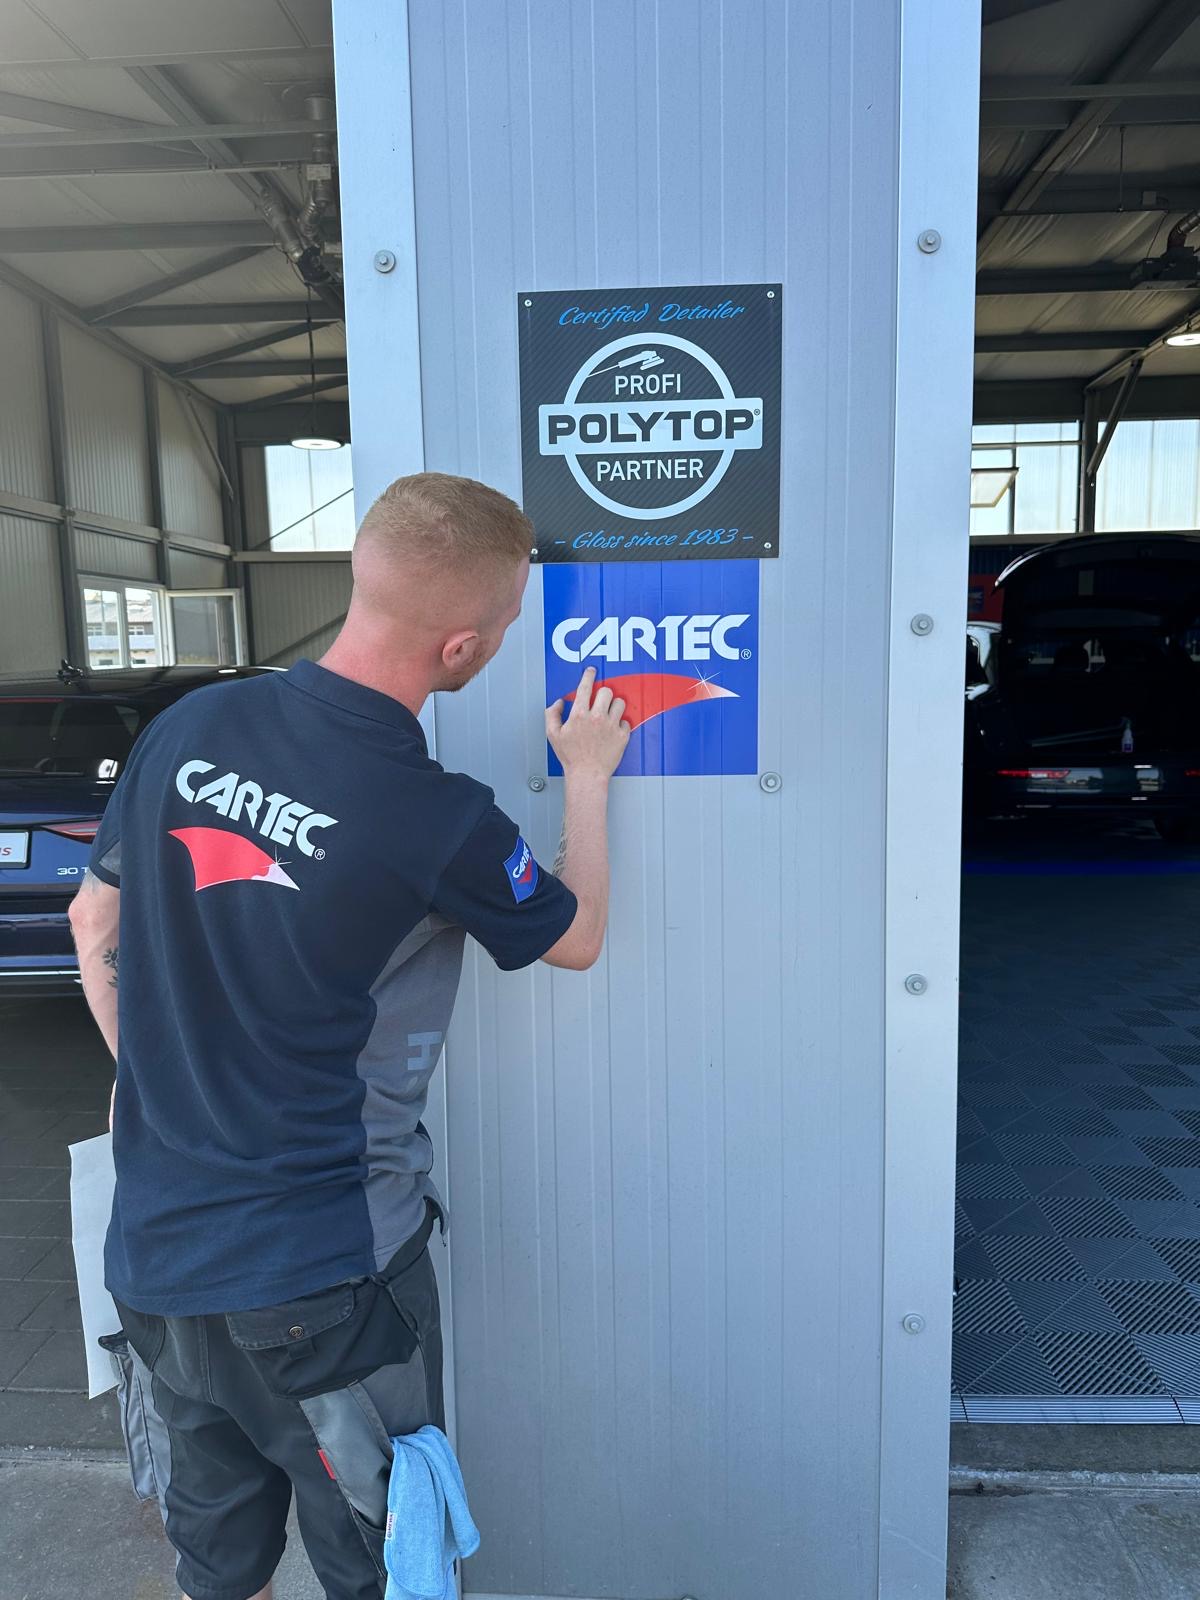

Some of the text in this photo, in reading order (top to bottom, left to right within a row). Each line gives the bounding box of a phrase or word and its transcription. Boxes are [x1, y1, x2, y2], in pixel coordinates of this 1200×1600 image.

[559, 300, 745, 330] Certified Detailer
[614, 373, 681, 395] PROFI
[596, 458, 704, 482] PARTNER
[572, 530, 625, 549] Gloss
[624, 531, 679, 548] since
[679, 528, 739, 546] 1983
[57, 867, 79, 875] 30
